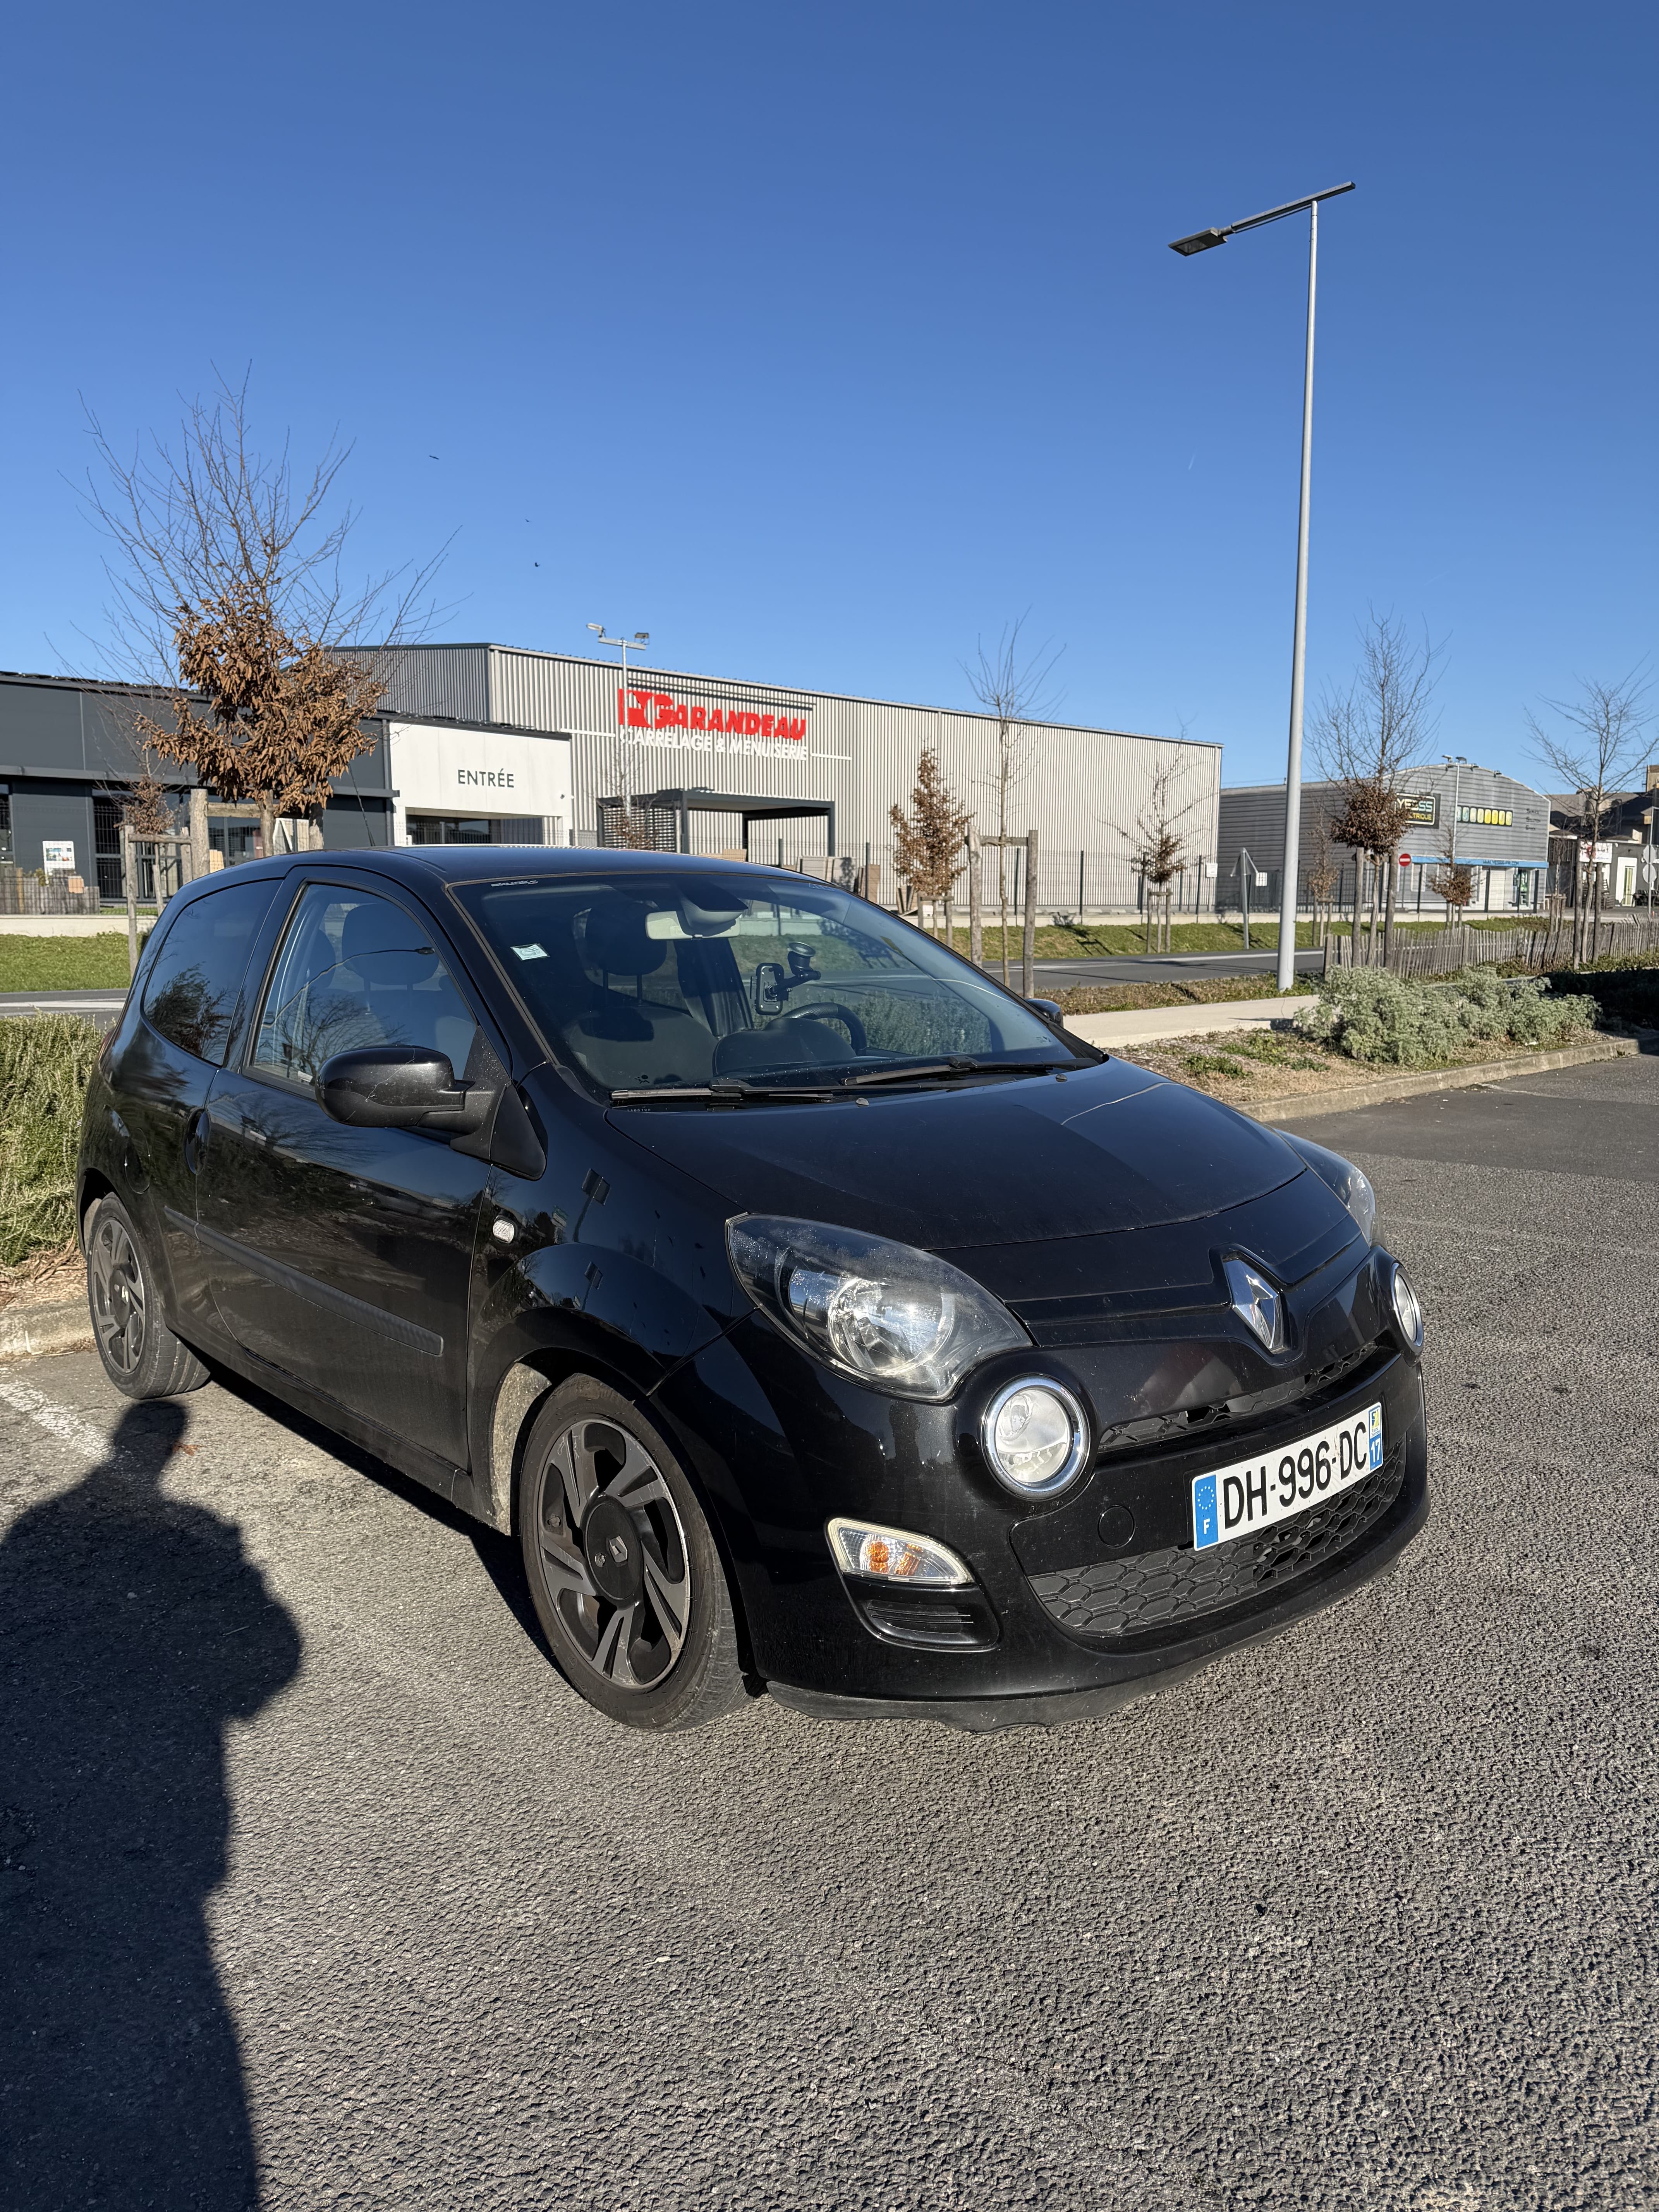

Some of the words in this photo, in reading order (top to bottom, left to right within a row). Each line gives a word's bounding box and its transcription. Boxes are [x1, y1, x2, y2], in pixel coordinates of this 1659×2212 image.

[644, 694, 806, 740] GARANDEAU
[714, 738, 726, 753] &
[729, 738, 807, 761] MENUISERIE
[457, 768, 514, 788] ENTRÉE
[1370, 1437, 1381, 1463] 17
[1223, 1422, 1367, 1530] DH-996-DC
[1203, 1518, 1210, 1534] F
